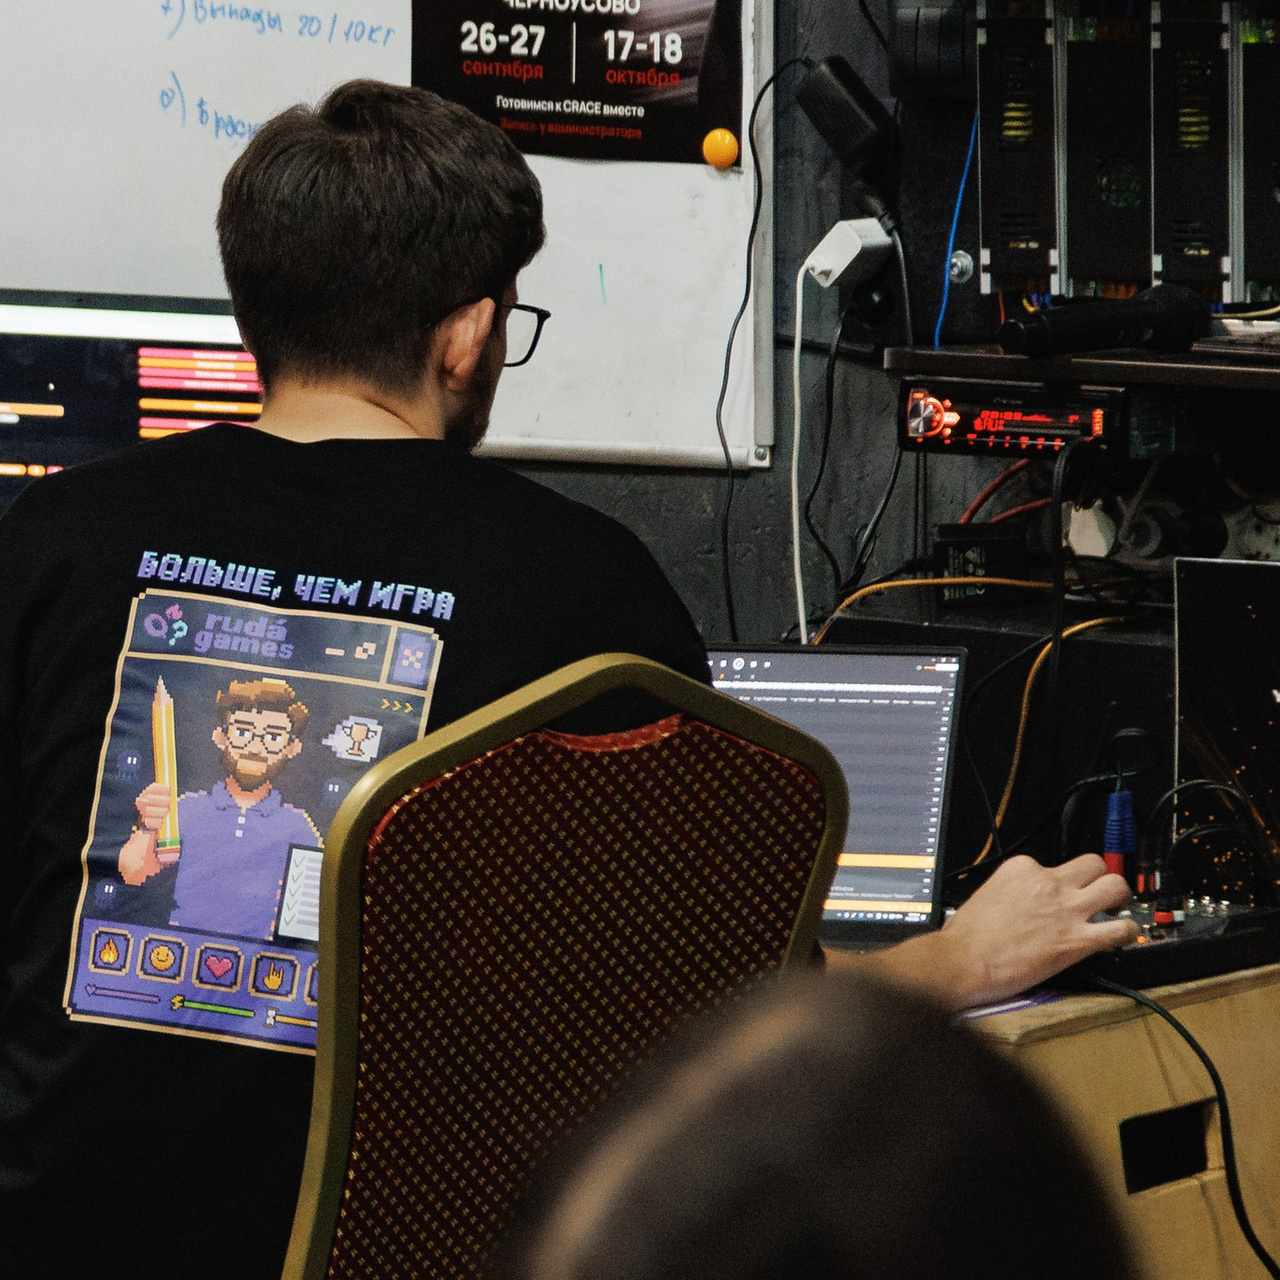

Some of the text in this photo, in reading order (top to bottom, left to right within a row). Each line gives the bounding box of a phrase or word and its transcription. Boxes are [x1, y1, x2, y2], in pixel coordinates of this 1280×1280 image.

[460, 20, 683, 65] 26-27 17-18
[462, 58, 681, 91] сентября октября
[495, 94, 645, 118] Готовимся к CRACE вместе
[137, 550, 455, 620] БОЛЬШЕ, ЧЕМ ИГРА
[194, 629, 295, 660] games
